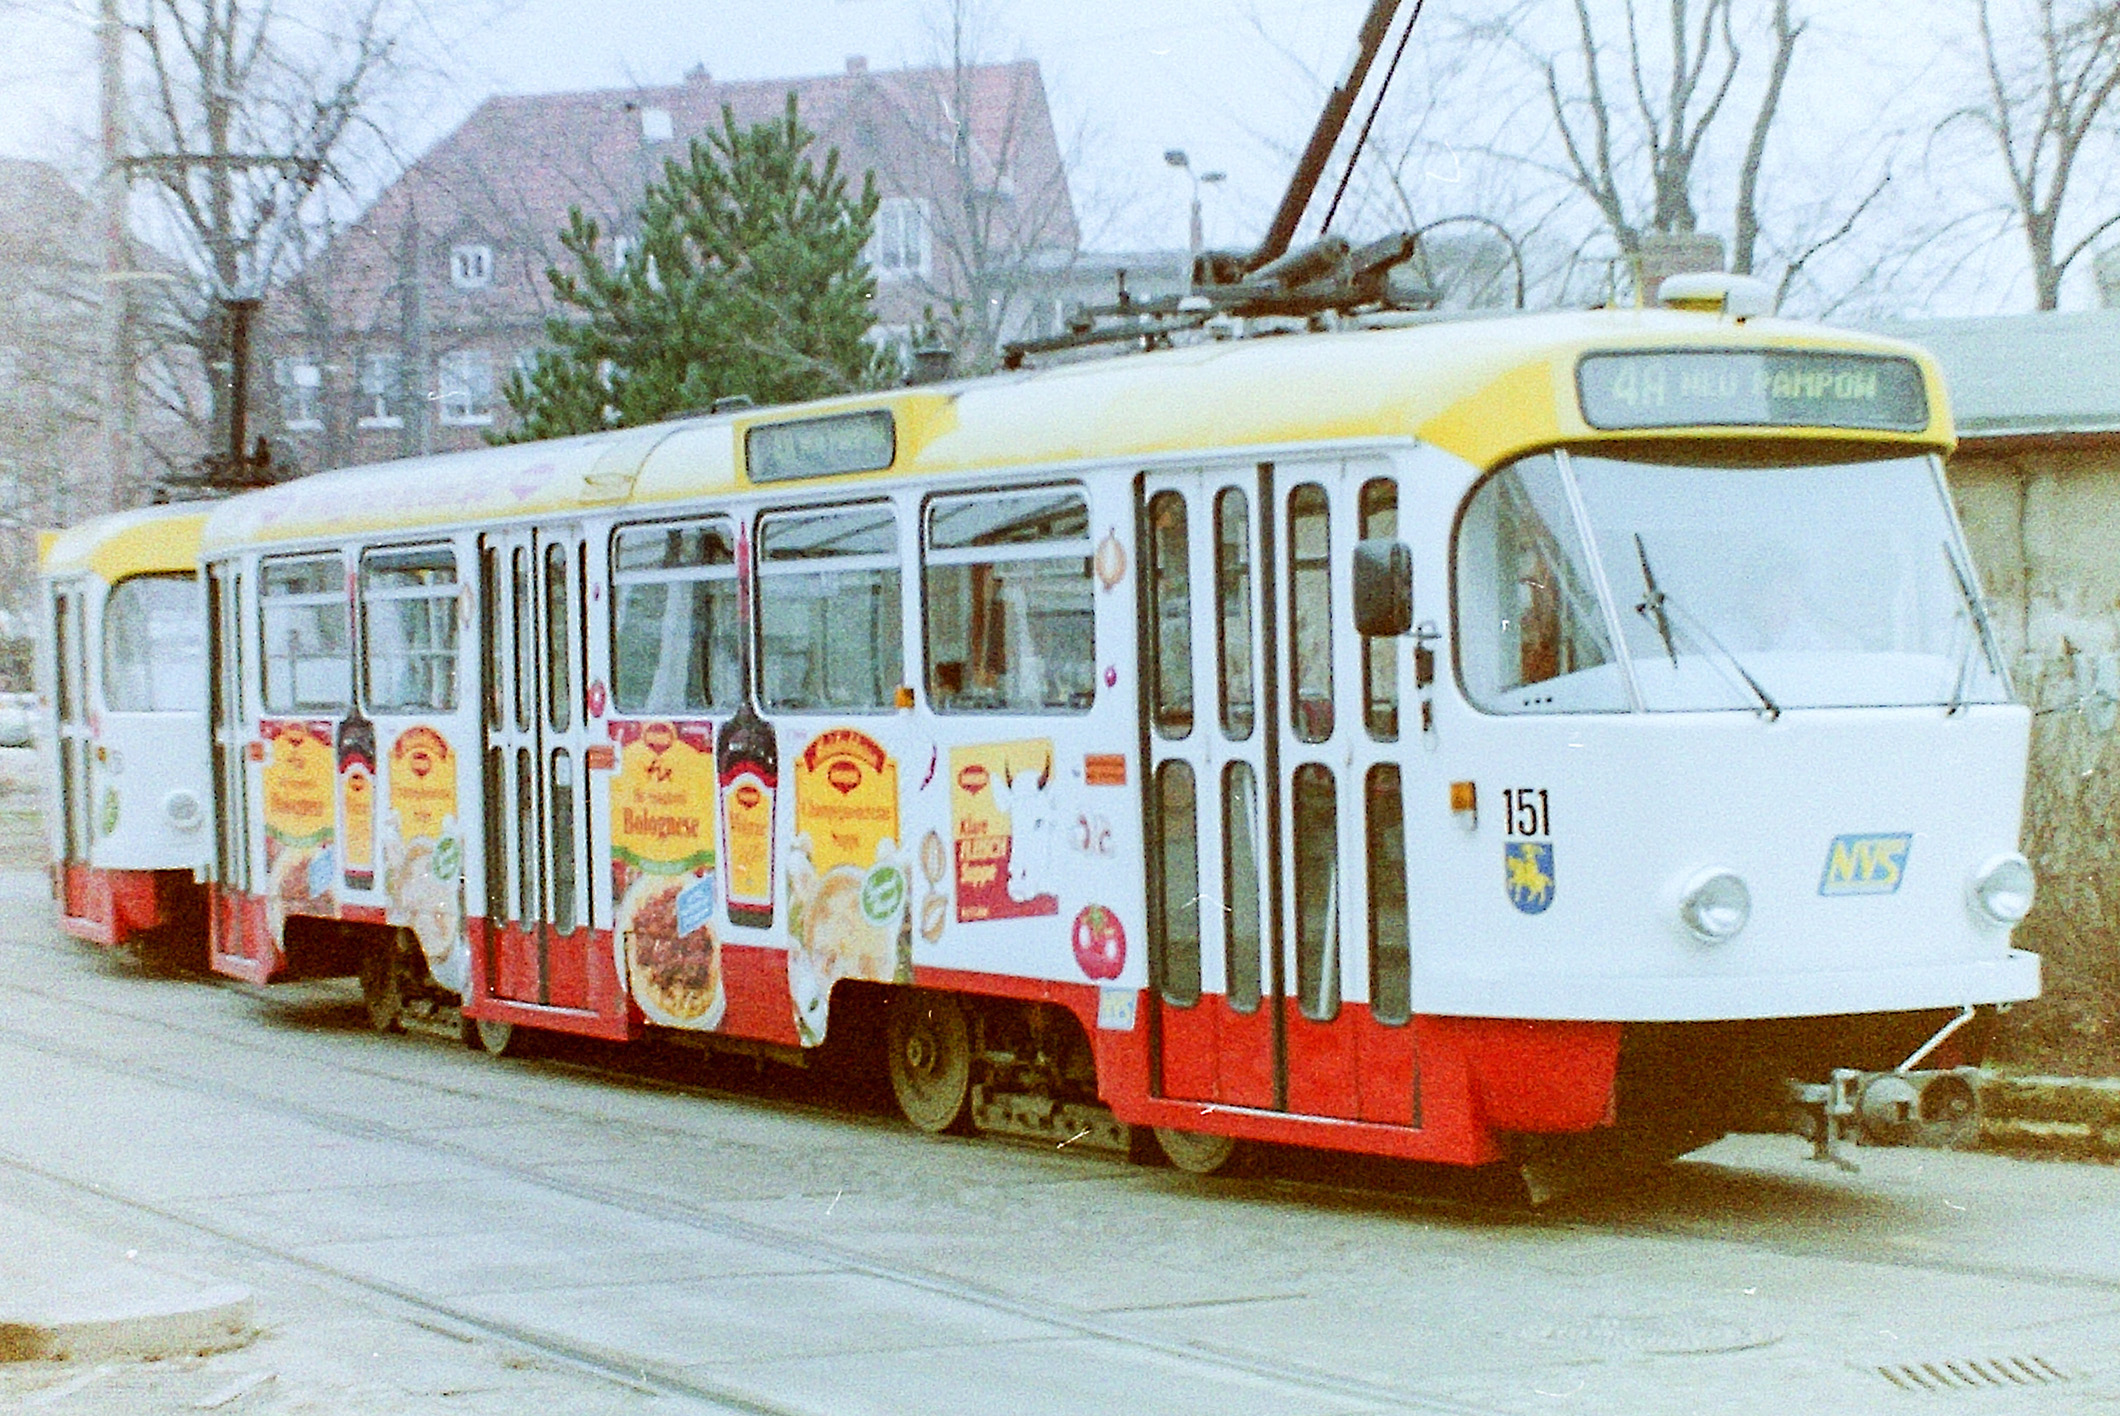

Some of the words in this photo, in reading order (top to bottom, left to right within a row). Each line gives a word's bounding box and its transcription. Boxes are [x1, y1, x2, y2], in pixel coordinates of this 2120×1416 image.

[623, 806, 700, 839] Bolognese
[1502, 788, 1551, 837] 151
[1829, 838, 1907, 884] NVS
